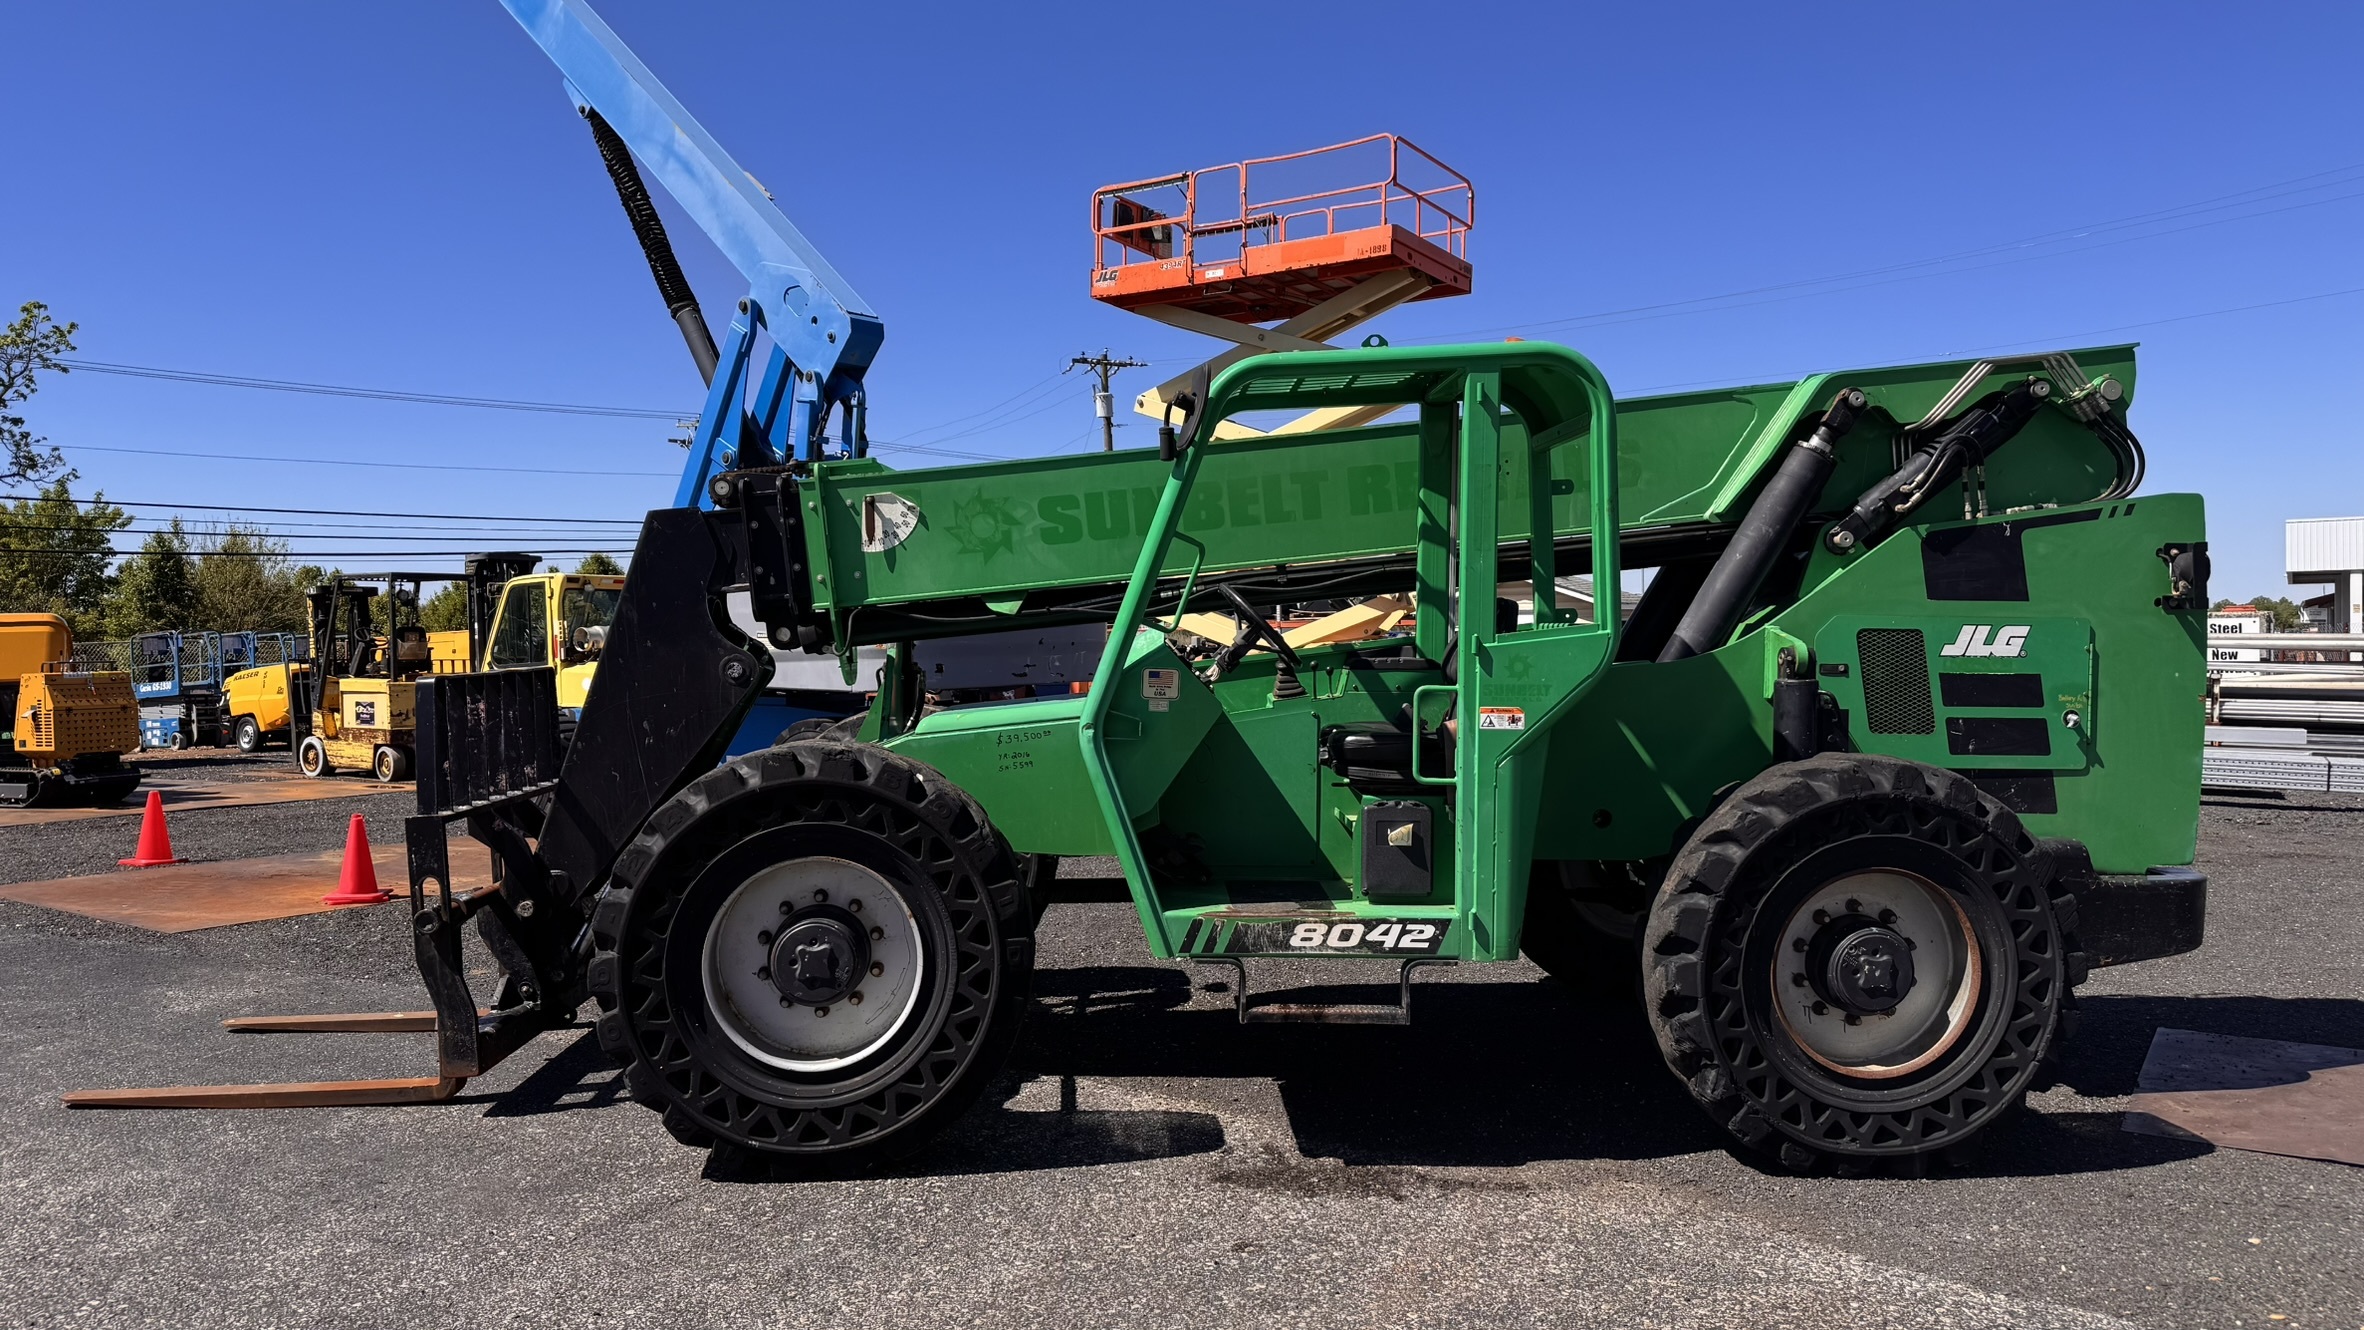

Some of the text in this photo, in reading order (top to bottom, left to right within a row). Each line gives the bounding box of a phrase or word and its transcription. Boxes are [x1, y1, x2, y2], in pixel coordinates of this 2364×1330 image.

[1095, 269, 1118, 283] JLG
[2209, 622, 2243, 634] Steel
[1938, 624, 2032, 658] JLG
[2211, 650, 2239, 661] New
[233, 671, 260, 682] KAESER
[1288, 922, 1437, 949] 8042
